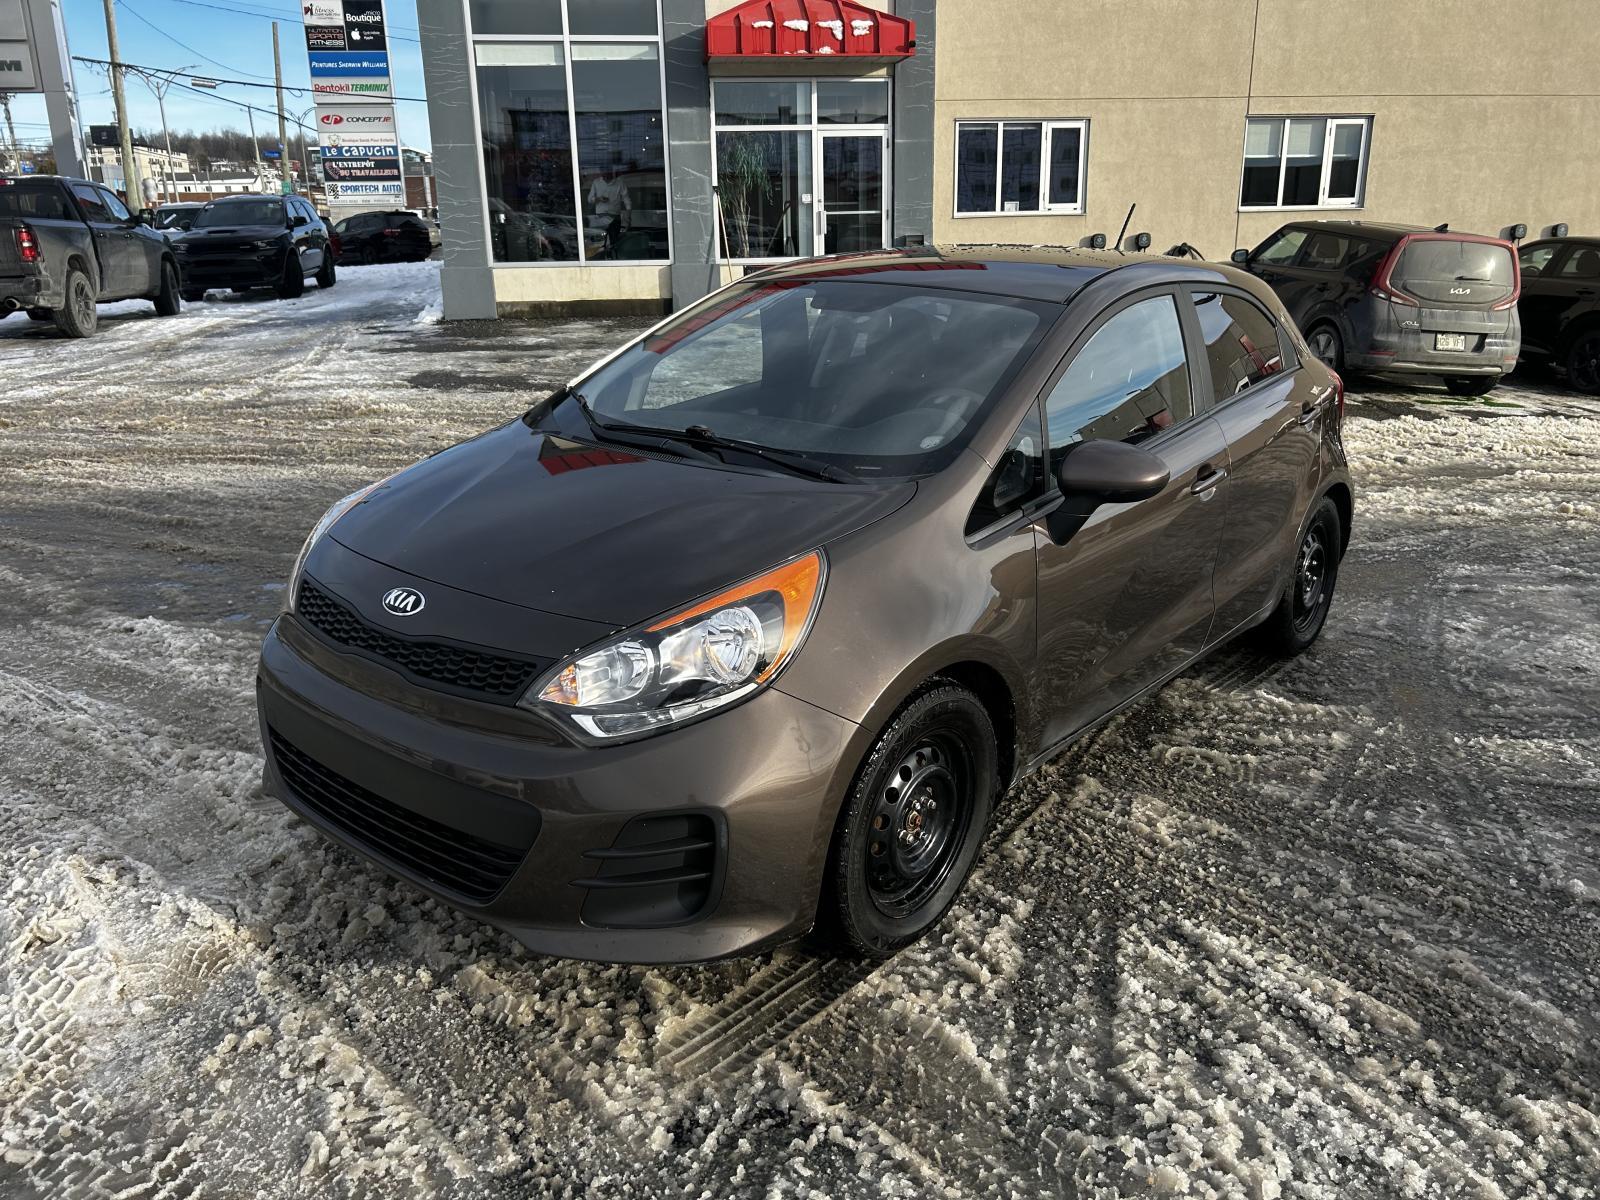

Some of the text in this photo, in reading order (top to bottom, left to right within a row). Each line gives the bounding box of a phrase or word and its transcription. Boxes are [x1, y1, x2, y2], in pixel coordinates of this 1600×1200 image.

[346, 13, 382, 23] Boutique
[314, 83, 389, 92] Rentokil TERMINIX
[340, 184, 402, 193] SPORTECH AUTO
[385, 589, 417, 612] KIA
